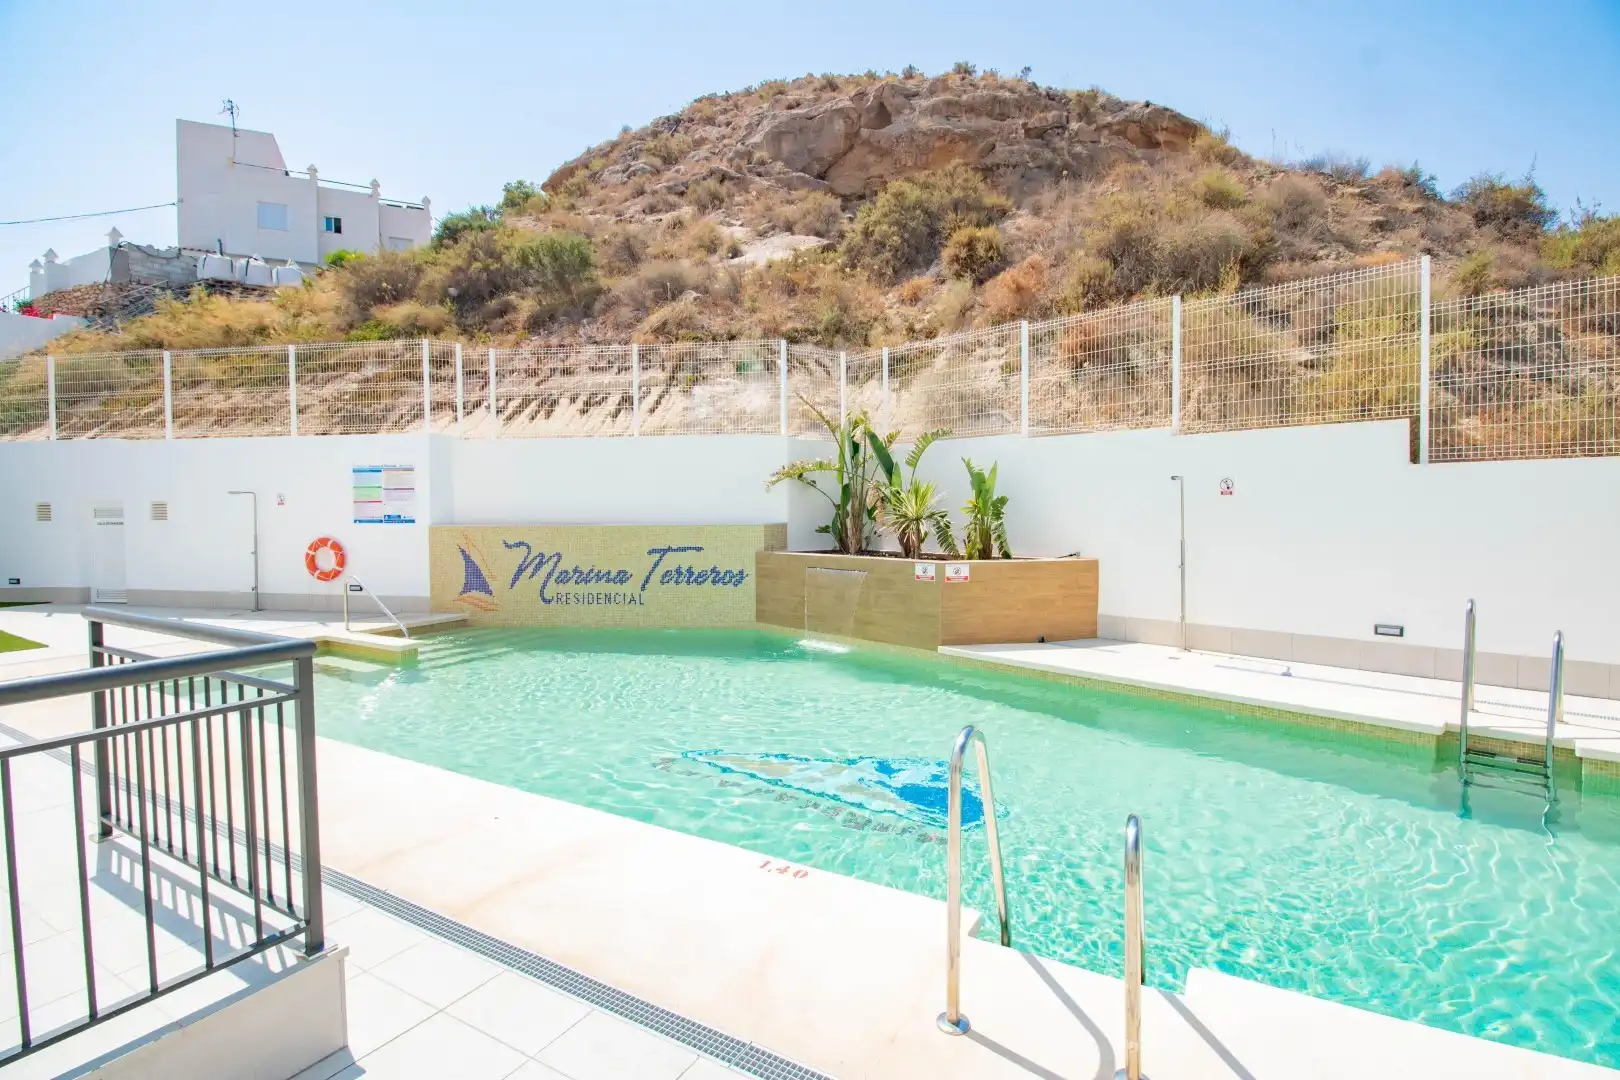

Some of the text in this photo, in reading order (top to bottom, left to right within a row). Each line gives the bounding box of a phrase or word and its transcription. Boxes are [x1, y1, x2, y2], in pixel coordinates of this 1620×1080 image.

[503, 540, 748, 605] Marina Terreros
[556, 593, 645, 605] RESIDENCIAL
